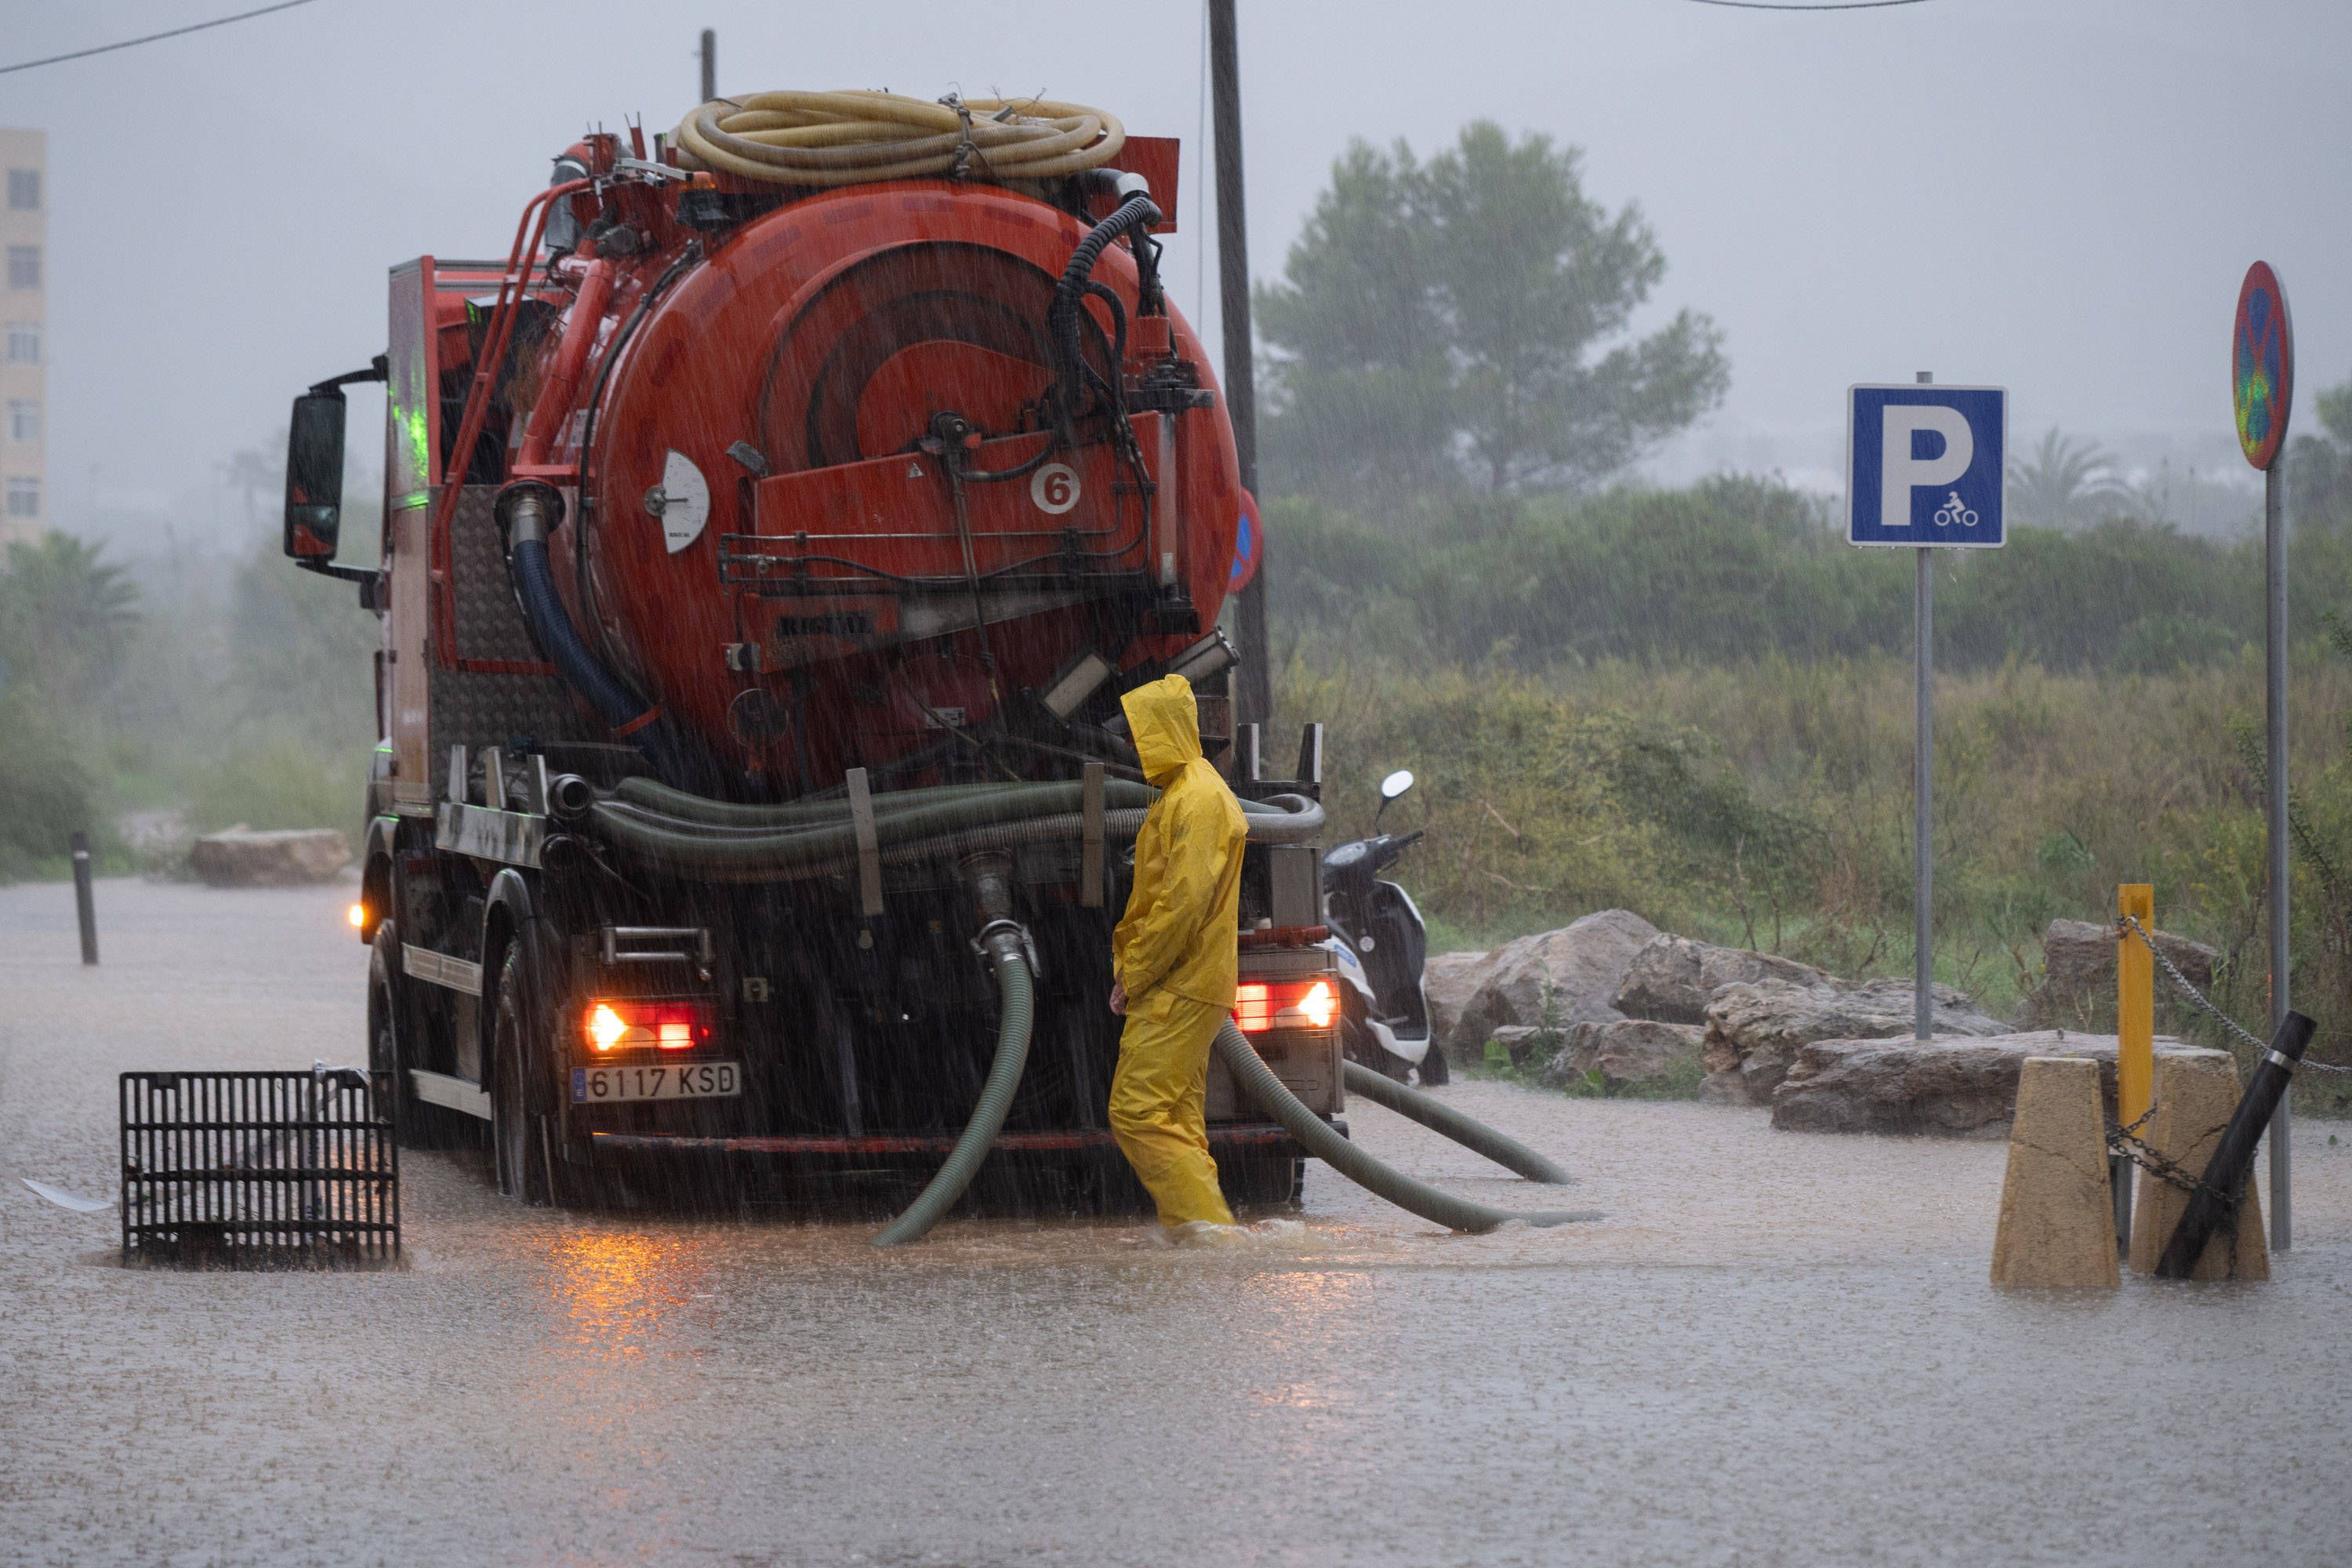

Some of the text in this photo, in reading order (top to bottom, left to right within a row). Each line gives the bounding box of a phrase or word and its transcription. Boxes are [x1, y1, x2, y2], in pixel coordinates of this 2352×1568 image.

[1882, 405, 1974, 526] P
[1044, 472, 1071, 506] 6
[591, 1065, 734, 1097] 6117 KSD
